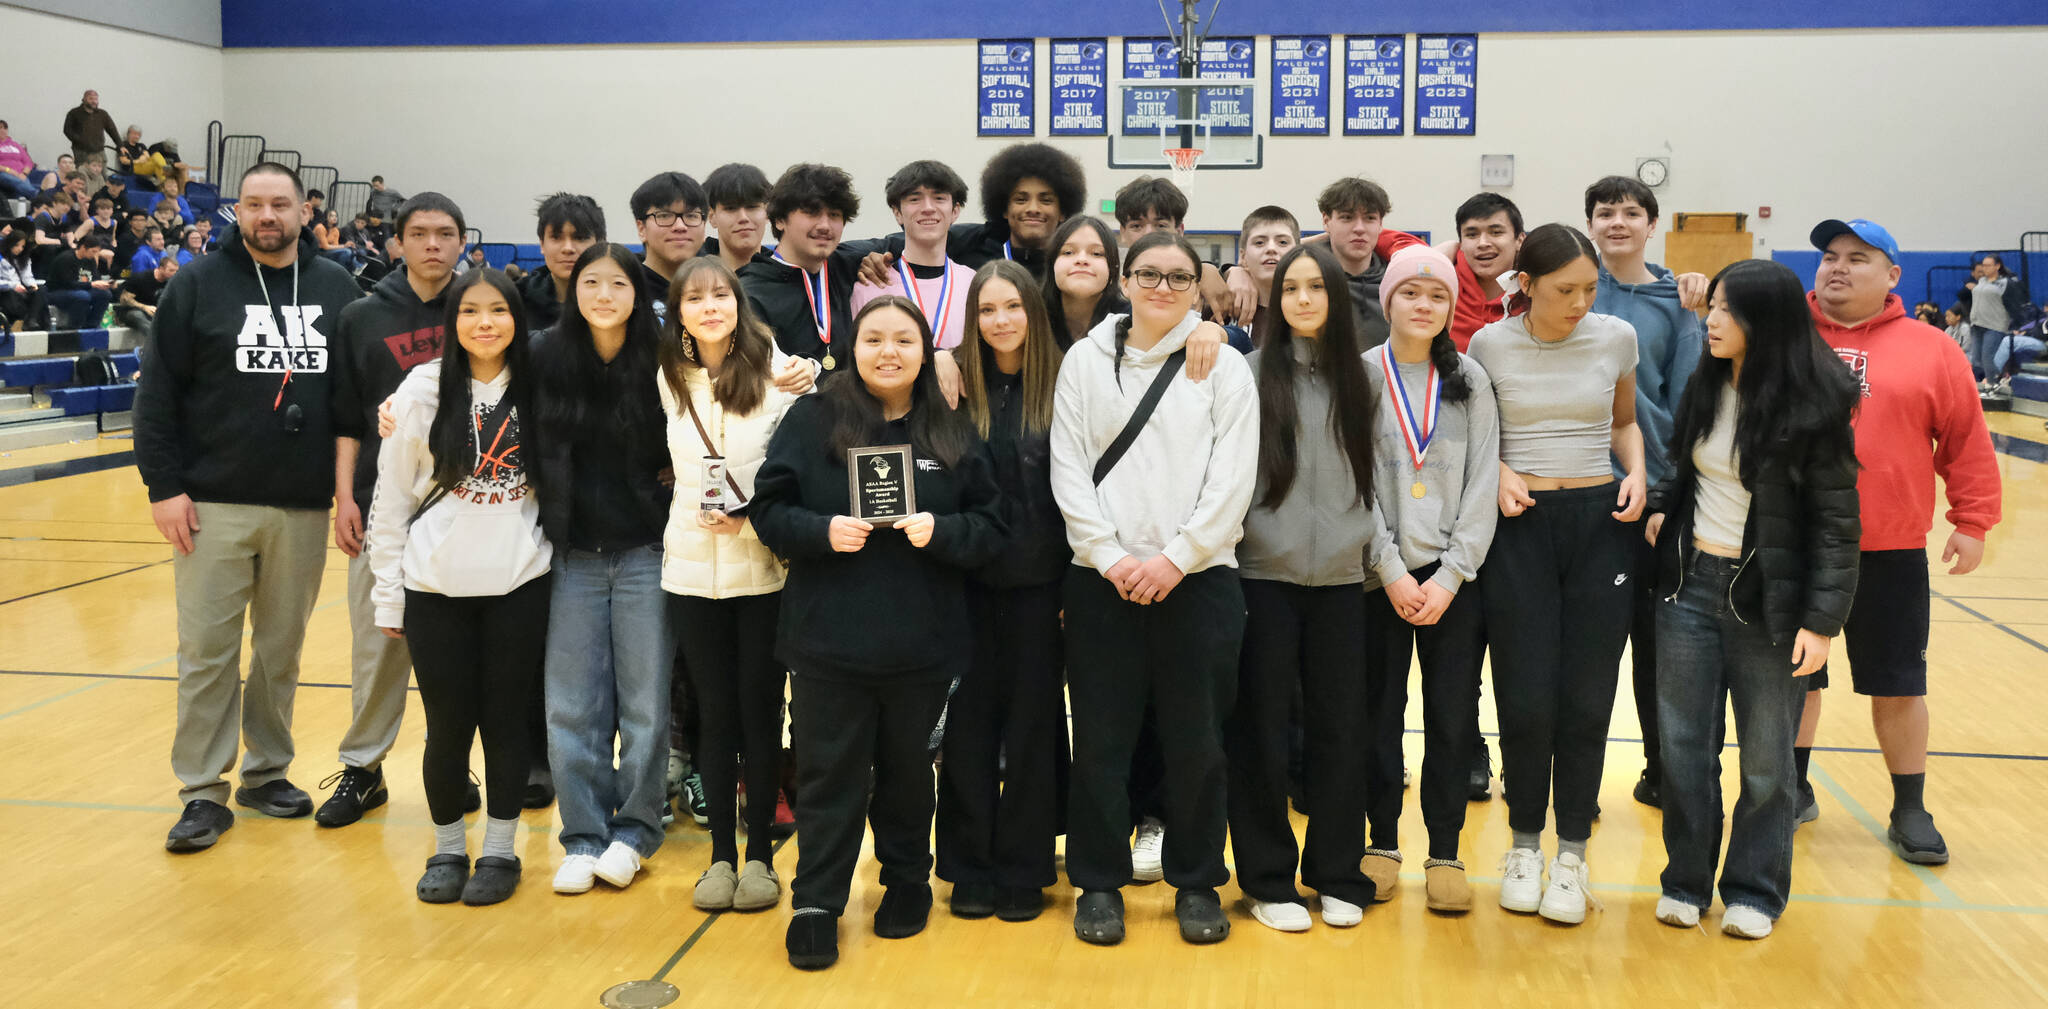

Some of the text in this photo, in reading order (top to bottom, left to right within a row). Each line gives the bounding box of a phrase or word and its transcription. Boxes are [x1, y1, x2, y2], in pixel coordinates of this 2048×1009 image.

[982, 74, 1030, 88] SOFTBALL
[1054, 74, 1103, 88] SOFTBALL
[1281, 74, 1320, 88] SOCCER
[1419, 74, 1473, 88] BASKETBALL
[988, 90, 1024, 98] 2016
[1061, 89, 1096, 98] 2017
[1134, 91, 1170, 100] 2017
[1282, 89, 1319, 97] 2021
[1354, 89, 1395, 97] 2023
[1426, 89, 1466, 97] 2023
[991, 104, 1020, 116] STATE
[1064, 103, 1093, 116] STATE
[1137, 102, 1166, 115] STATE
[1210, 101, 1240, 114] STATE
[1285, 106, 1315, 118] STATE
[1358, 106, 1389, 118] STATE
[1430, 106, 1460, 118] STATE
[981, 116, 1030, 129] CHAMPIONS
[1054, 116, 1102, 129] CHAMPIONS
[1274, 118, 1325, 129] CHAMPIONS
[1348, 118, 1400, 130] RUNNER UP
[1421, 118, 1469, 129] RUNNER UP
[237, 305, 327, 346] AK
[247, 350, 319, 369] KAKE
[472, 492, 487, 504] IS
[489, 491, 505, 504] IN
